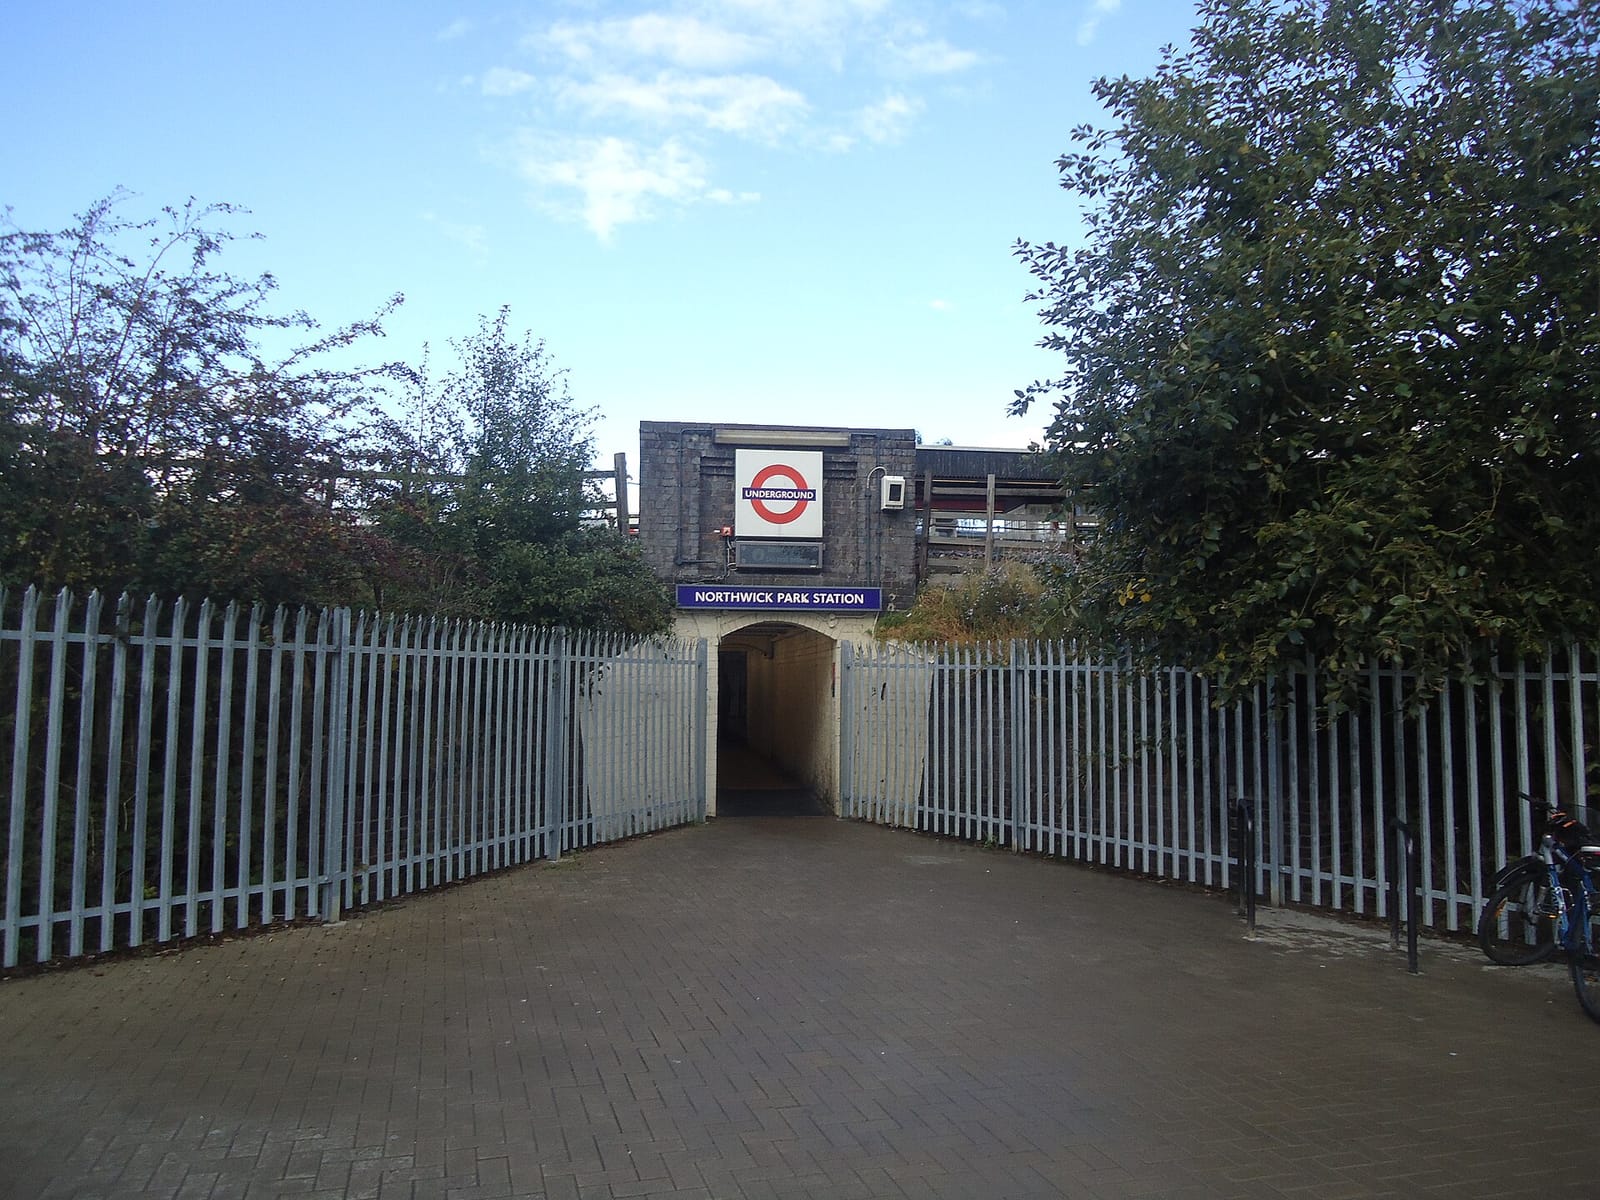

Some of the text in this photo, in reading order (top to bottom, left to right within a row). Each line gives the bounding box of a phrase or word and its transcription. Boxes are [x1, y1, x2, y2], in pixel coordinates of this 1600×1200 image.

[745, 490, 814, 499] UNDERGROUND
[695, 591, 864, 604] NORTHWICK PARK STATION
